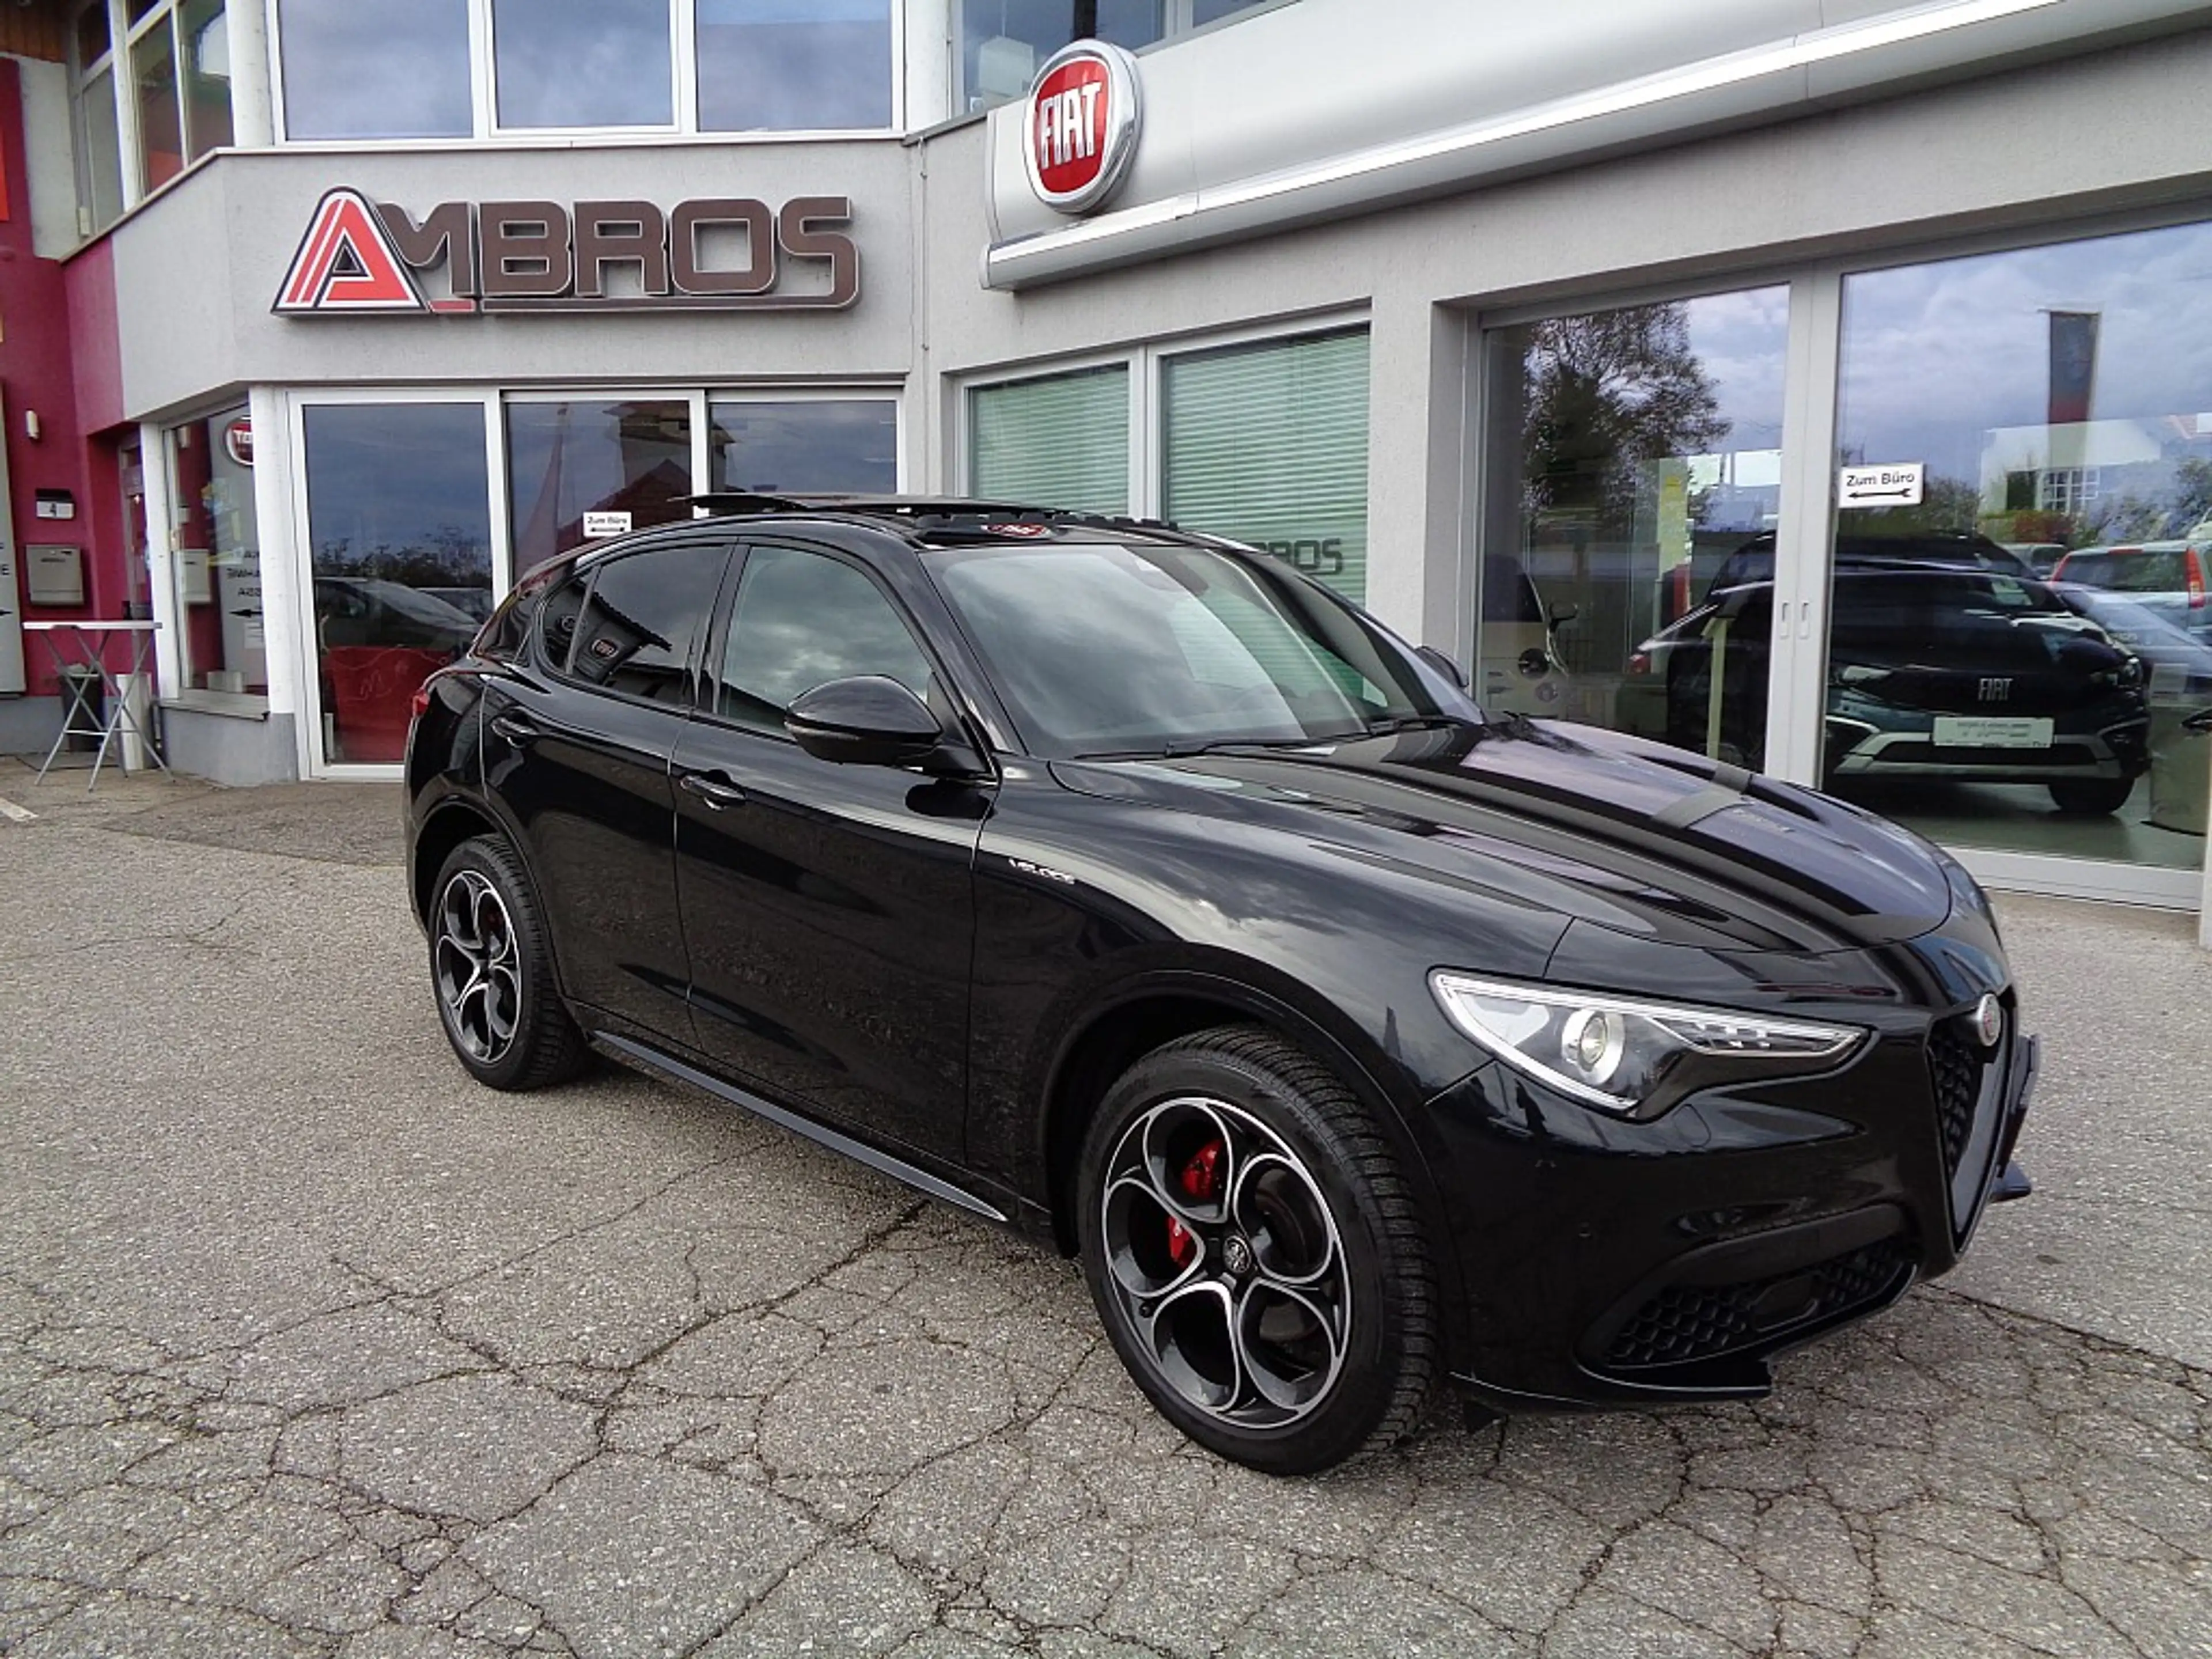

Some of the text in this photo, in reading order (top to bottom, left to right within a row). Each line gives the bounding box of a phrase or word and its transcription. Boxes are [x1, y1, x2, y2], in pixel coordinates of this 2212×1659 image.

[1040, 82, 1102, 169] FIAT
[271, 185, 859, 314] AMBROS
[1846, 471, 1915, 487] Zum Büro
[1978, 678, 2013, 701] FIAT
